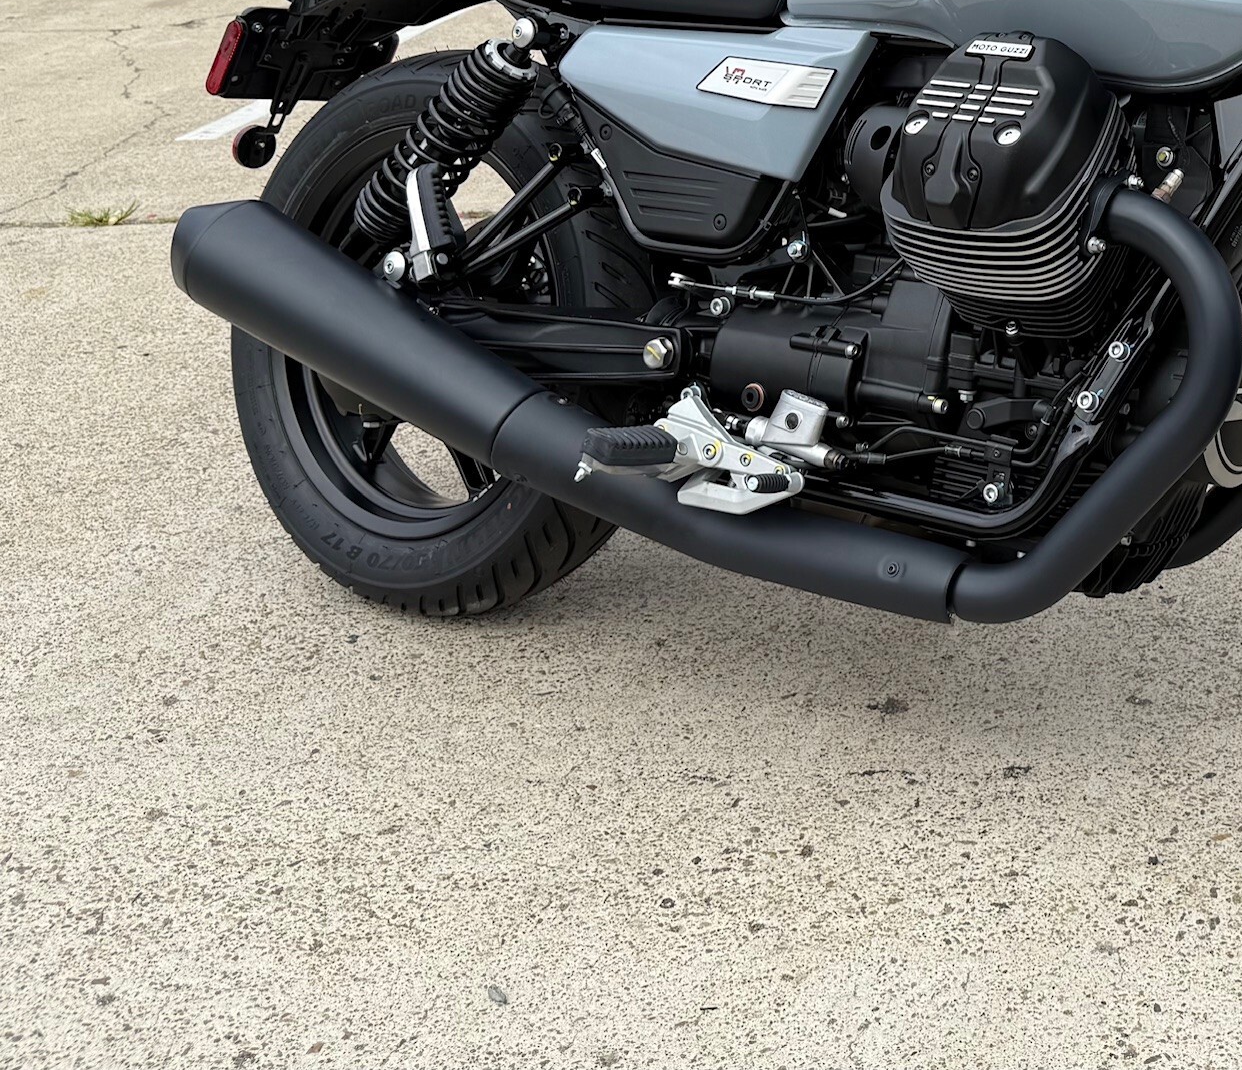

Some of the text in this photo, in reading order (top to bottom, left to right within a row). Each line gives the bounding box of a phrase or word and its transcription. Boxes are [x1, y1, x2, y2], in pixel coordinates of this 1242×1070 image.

[971, 43, 1029, 55] MOTO GUZZI
[723, 73, 772, 87] SPORT
[320, 530, 344, 551] 17
